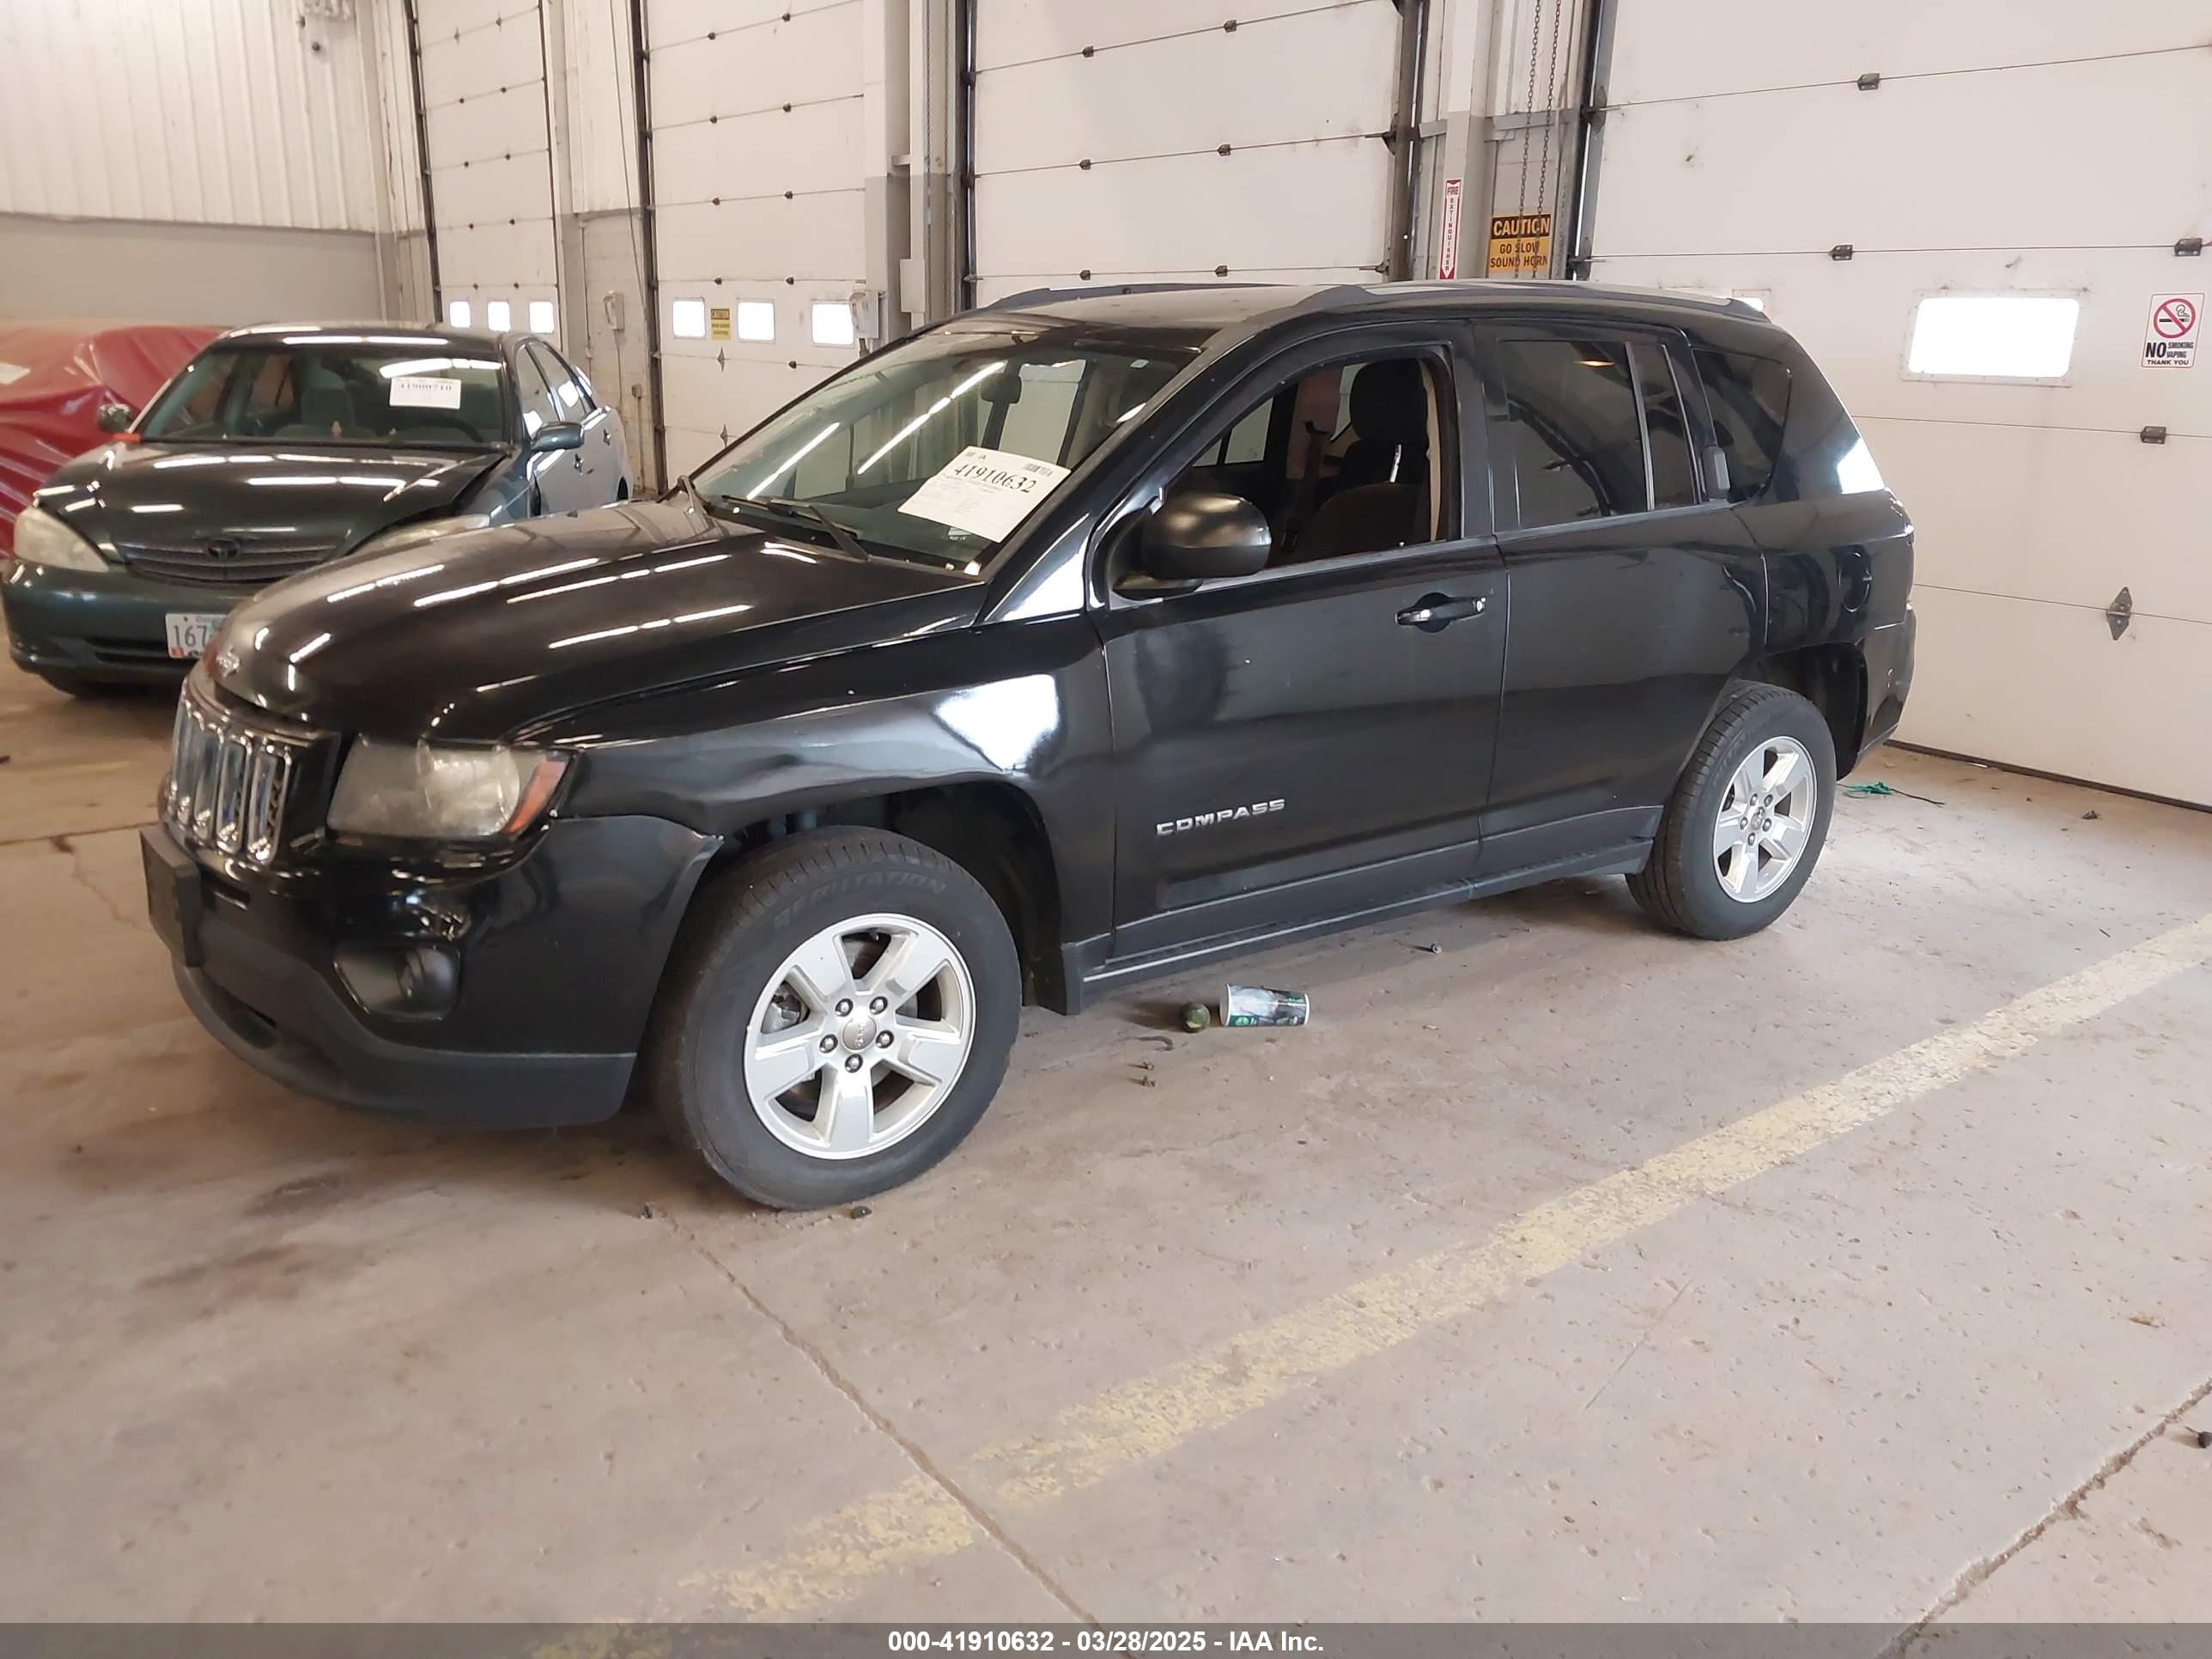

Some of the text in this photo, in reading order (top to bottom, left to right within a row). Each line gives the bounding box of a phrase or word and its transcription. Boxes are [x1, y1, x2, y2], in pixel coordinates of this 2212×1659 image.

[1493, 217, 1549, 236] CAUTION
[1499, 240, 1540, 254] GO SLOW
[1490, 256, 1547, 269] SOUND HORN
[2145, 342, 2167, 358] NO
[954, 464, 1036, 493] 41910632
[1156, 799, 1285, 836] COMPASS
